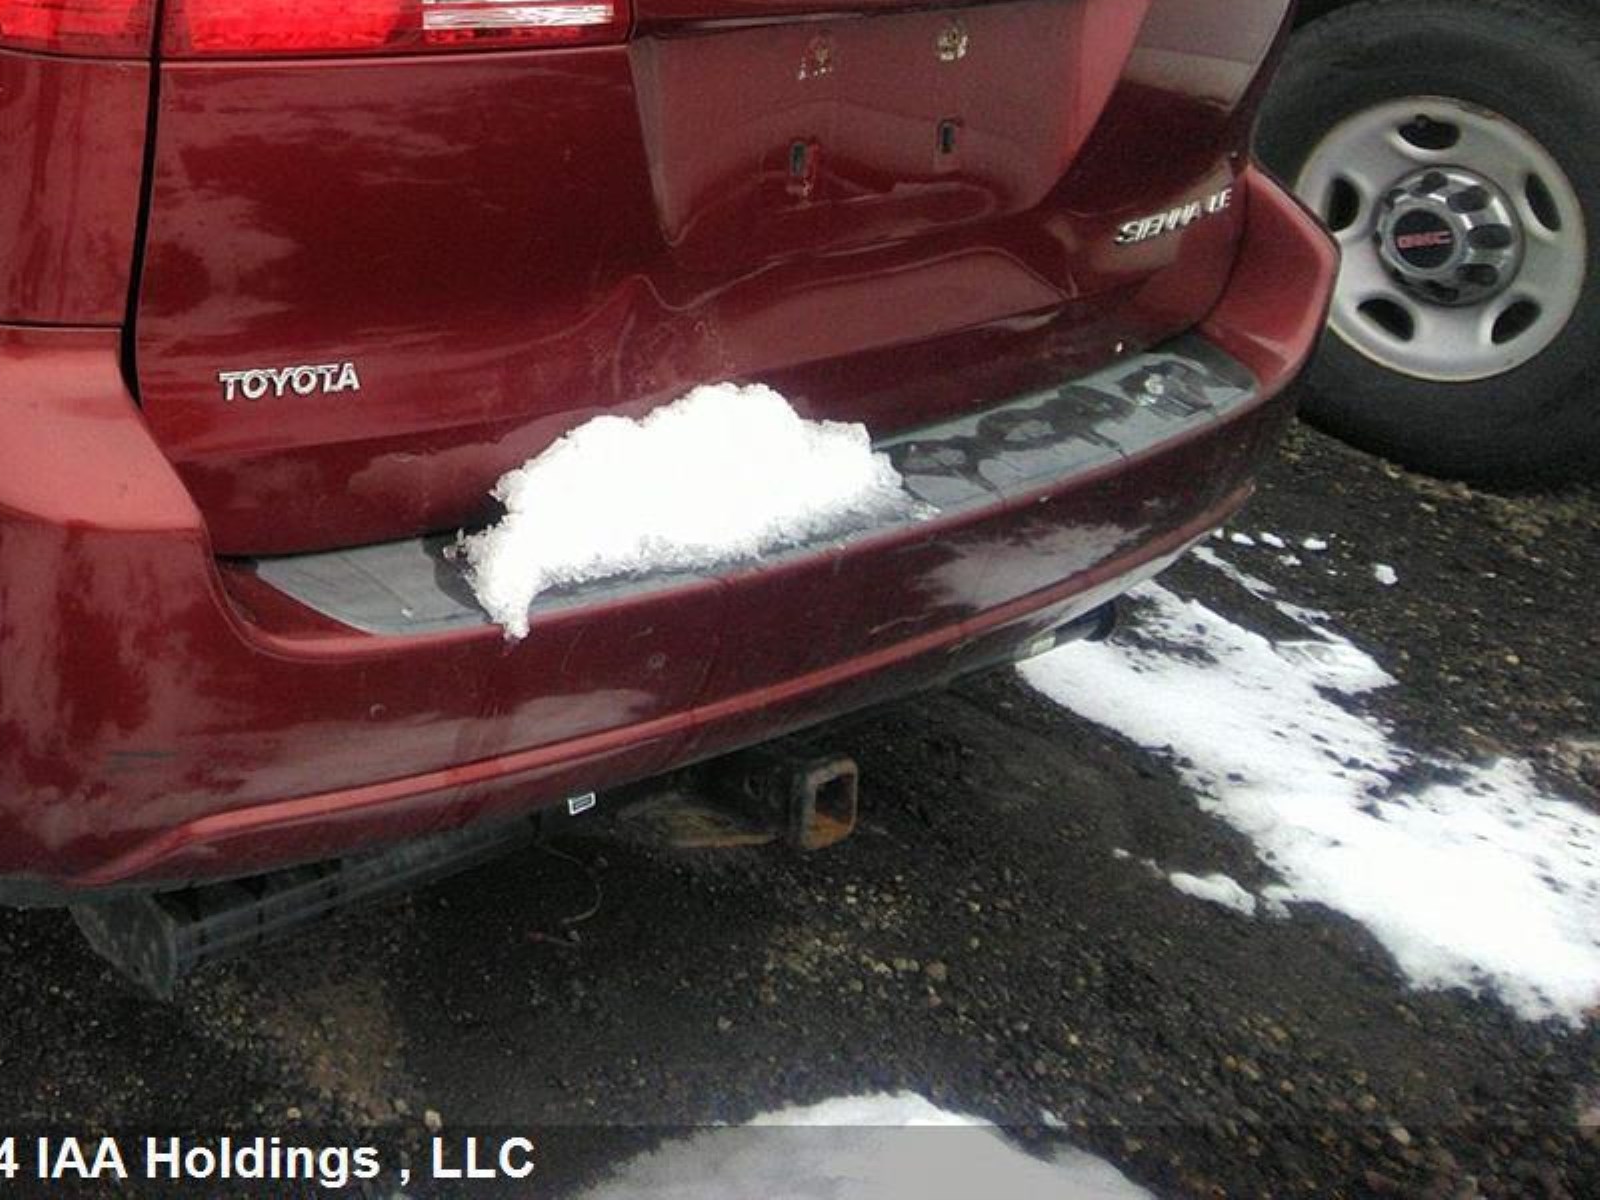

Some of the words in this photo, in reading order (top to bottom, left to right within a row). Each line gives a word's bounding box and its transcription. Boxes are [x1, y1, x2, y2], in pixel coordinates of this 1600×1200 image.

[1115, 200, 1202, 244] SIENNA
[1208, 188, 1232, 213] LE
[218, 362, 360, 401] TOYOTA
